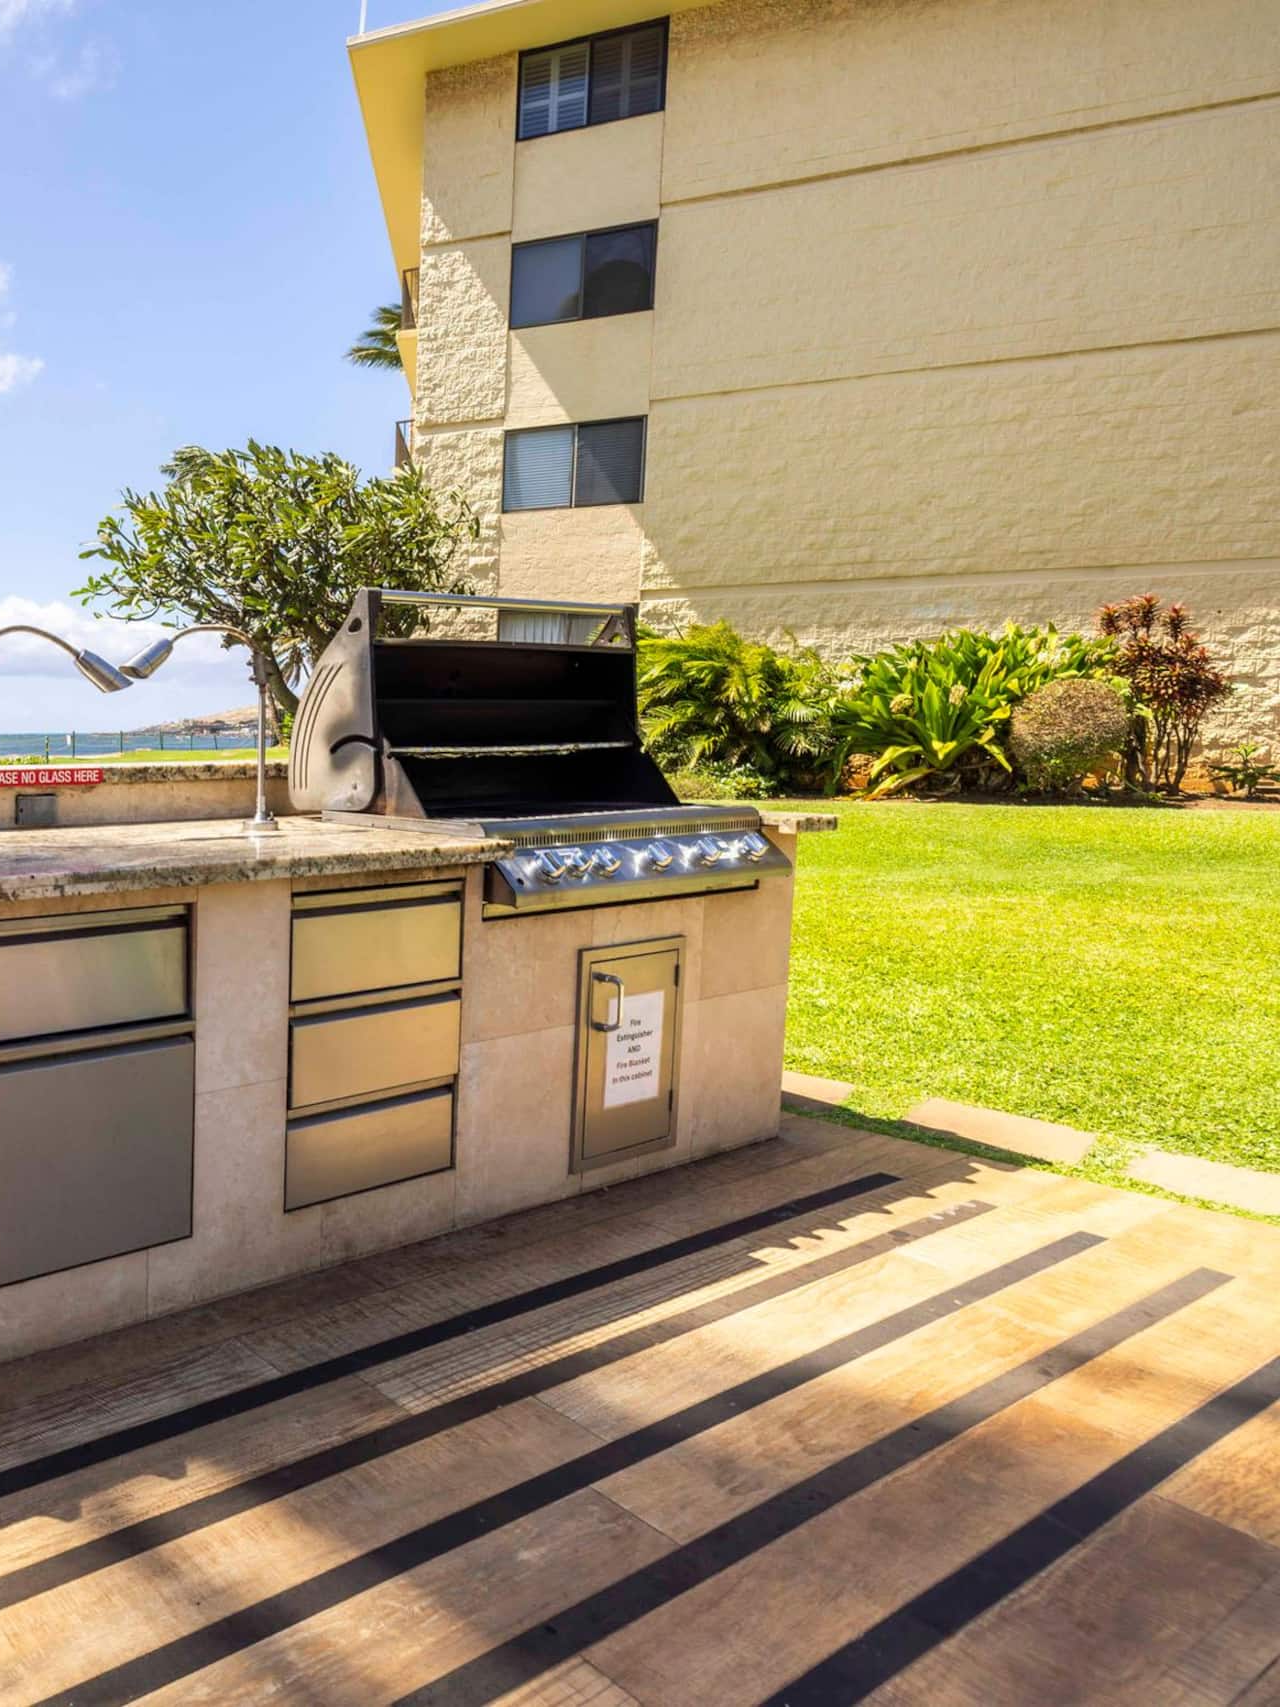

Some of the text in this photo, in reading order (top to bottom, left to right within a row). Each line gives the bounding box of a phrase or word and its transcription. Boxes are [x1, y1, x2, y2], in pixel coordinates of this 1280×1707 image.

[20, 771, 36, 784] NO
[39, 770, 71, 783] GLASS
[74, 769, 99, 782] HERE
[630, 1019, 641, 1027] Fire
[616, 1030, 653, 1042] Extinguisher
[627, 1044, 641, 1053] AND
